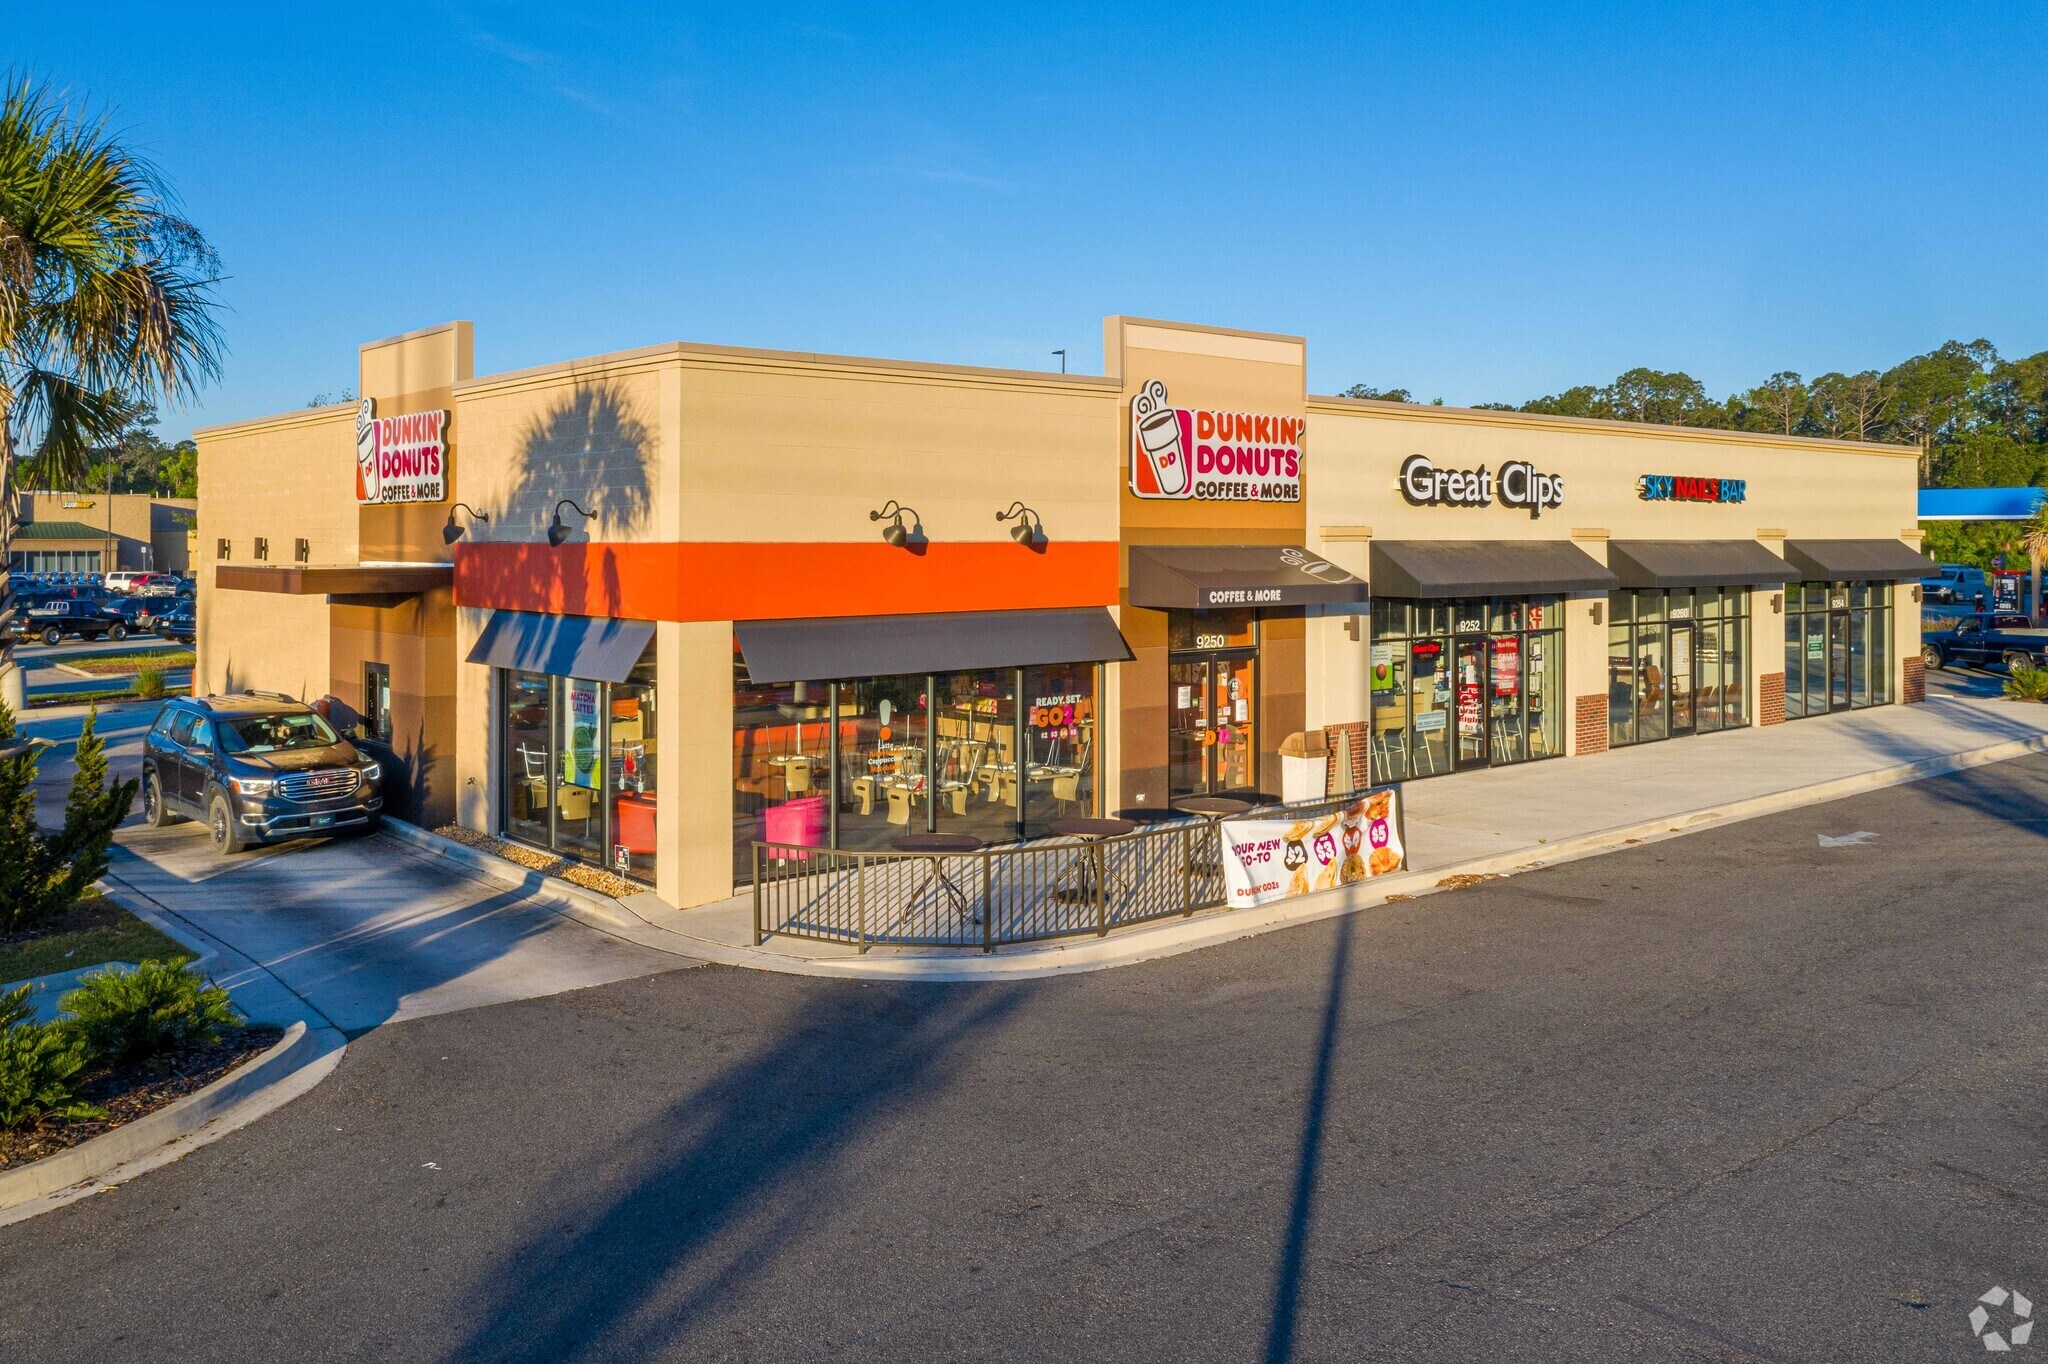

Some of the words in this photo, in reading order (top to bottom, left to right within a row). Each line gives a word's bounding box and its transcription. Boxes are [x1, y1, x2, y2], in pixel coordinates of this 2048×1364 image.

[382, 412, 442, 447] DUNKIN'
[1197, 411, 1303, 445] DUNKIN'
[382, 445, 440, 479] DONUTS
[1159, 451, 1176, 469] DD
[1197, 445, 1298, 477] DONUTS
[382, 485, 410, 501] COFFEE
[411, 485, 416, 498] &
[417, 482, 440, 499] MORE
[1195, 481, 1249, 497] COFFEE
[1250, 484, 1259, 497] &
[1260, 483, 1299, 499] MORE
[1406, 457, 1492, 501] Great
[1503, 463, 1564, 513] Clips
[1646, 475, 1673, 498] SKY
[1676, 477, 1719, 501] NAILS
[1721, 479, 1746, 501] BAR
[1209, 591, 1246, 604] COFFEE
[1246, 590, 1254, 602] &
[1254, 589, 1282, 602] MORE
[1460, 620, 1480, 632] 9252
[1196, 634, 1225, 649] 9250
[570, 692, 595, 704] MATCHA
[1036, 696, 1065, 706] READY.
[1065, 694, 1082, 704] SET.
[572, 702, 594, 714] LATTES
[1371, 824, 1386, 844] $5
[1231, 842, 1256, 857] YOUR
[1256, 838, 1281, 851] NEW
[1285, 845, 1306, 866] $2
[1315, 841, 1335, 862] $3
